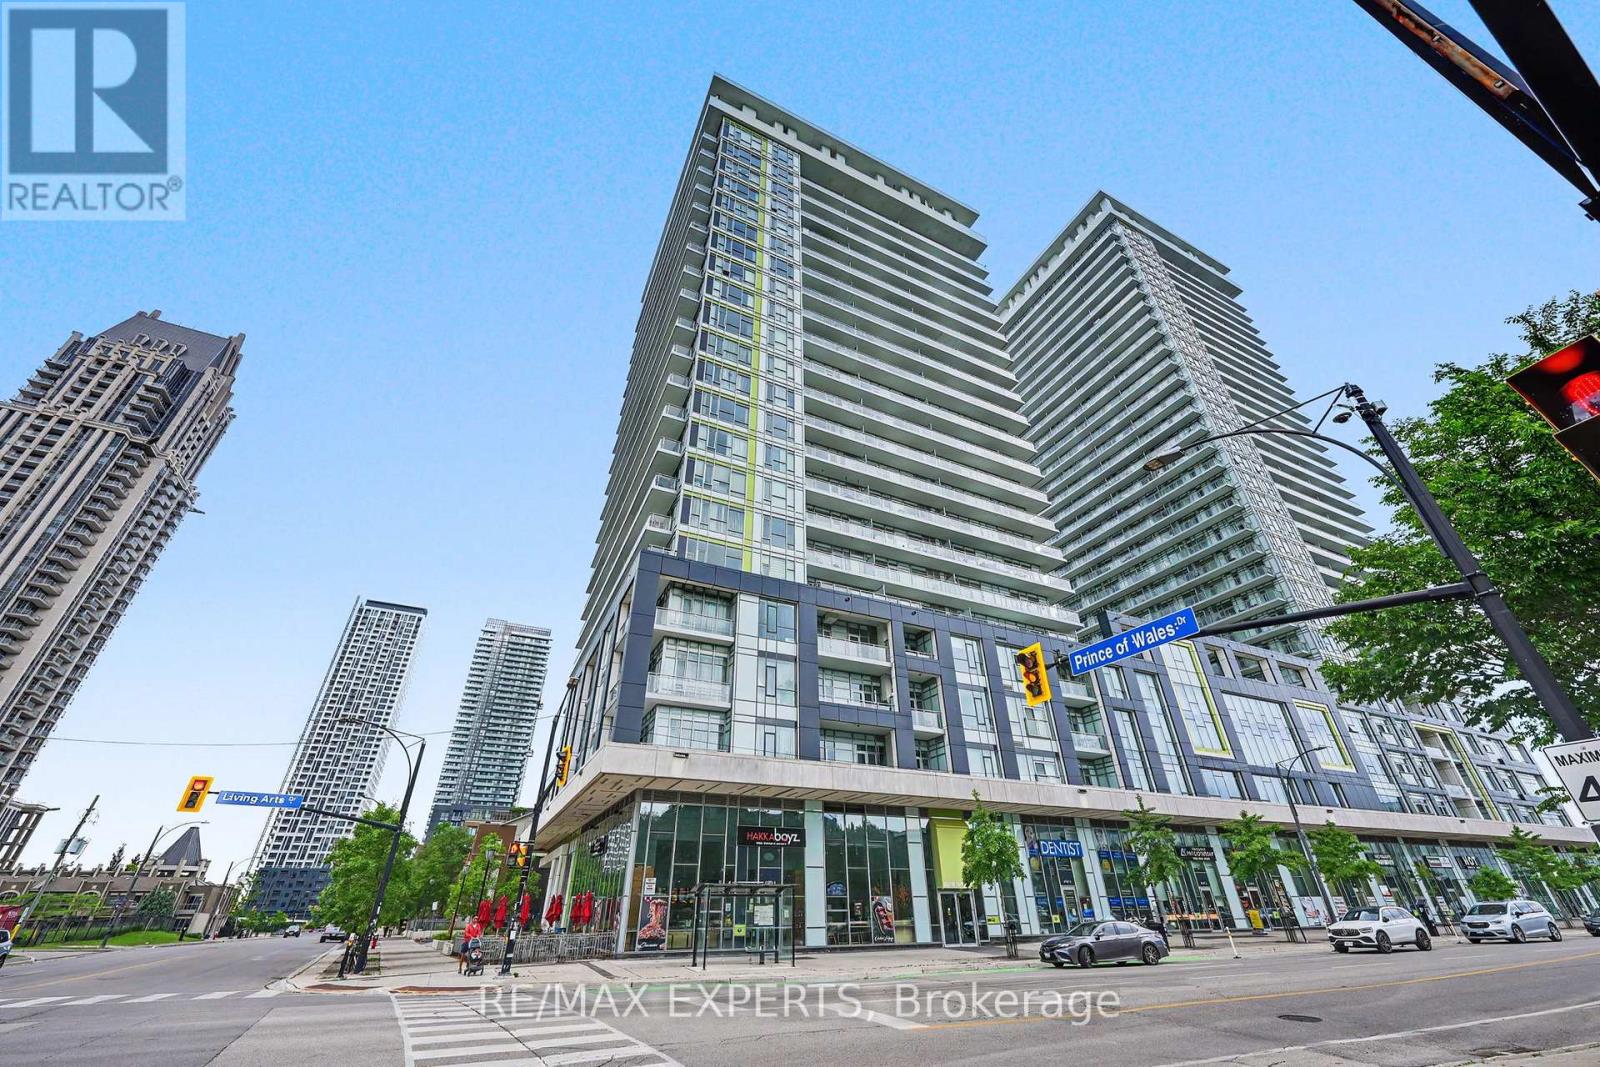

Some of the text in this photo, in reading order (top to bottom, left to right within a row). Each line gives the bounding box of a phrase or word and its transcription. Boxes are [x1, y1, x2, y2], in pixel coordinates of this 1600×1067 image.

[1074, 648, 1113, 670] Prince
[1116, 639, 1129, 655] of
[1131, 624, 1176, 649] Wales
[223, 793, 258, 804] Living
[260, 795, 285, 804] Arts
[1040, 840, 1080, 856] DENTIST
